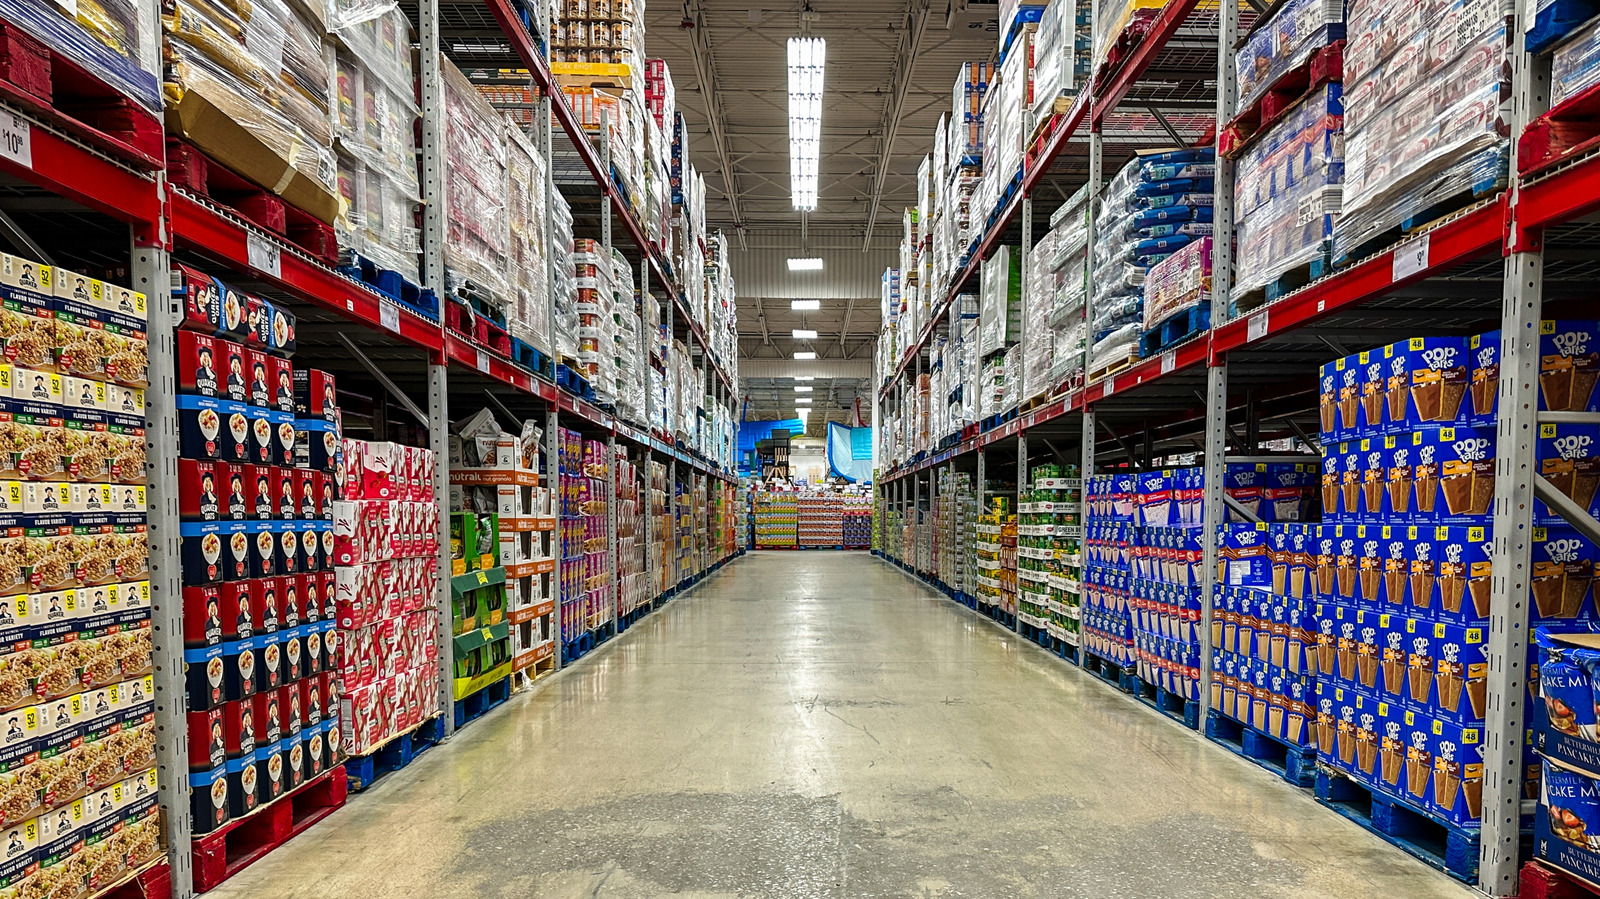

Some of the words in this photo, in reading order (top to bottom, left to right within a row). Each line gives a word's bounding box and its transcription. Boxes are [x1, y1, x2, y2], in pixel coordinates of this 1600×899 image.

[42, 270, 49, 281] 52
[93, 284, 100, 295] 52
[137, 297, 144, 307] 52
[1544, 323, 1553, 331] 48
[1429, 360, 1453, 371] tarts
[0, 372, 8, 383] 52
[52, 380, 60, 390] 52
[97, 387, 104, 397] 52
[1459, 450, 1485, 463] tarts
[11, 487, 19, 498] 52
[61, 488, 68, 498] 52
[103, 489, 109, 499] 52
[67, 594, 74, 606] 52
[110, 589, 116, 600] 52
[18, 601, 26, 612] 52
[111, 689, 117, 700] 52
[73, 700, 79, 712] 52
[27, 713, 35, 725] 52
[1558, 742, 1596, 766] PANCAKE
[114, 788, 120, 798] 52
[74, 806, 80, 817] 52
[27, 824, 35, 836] 52
